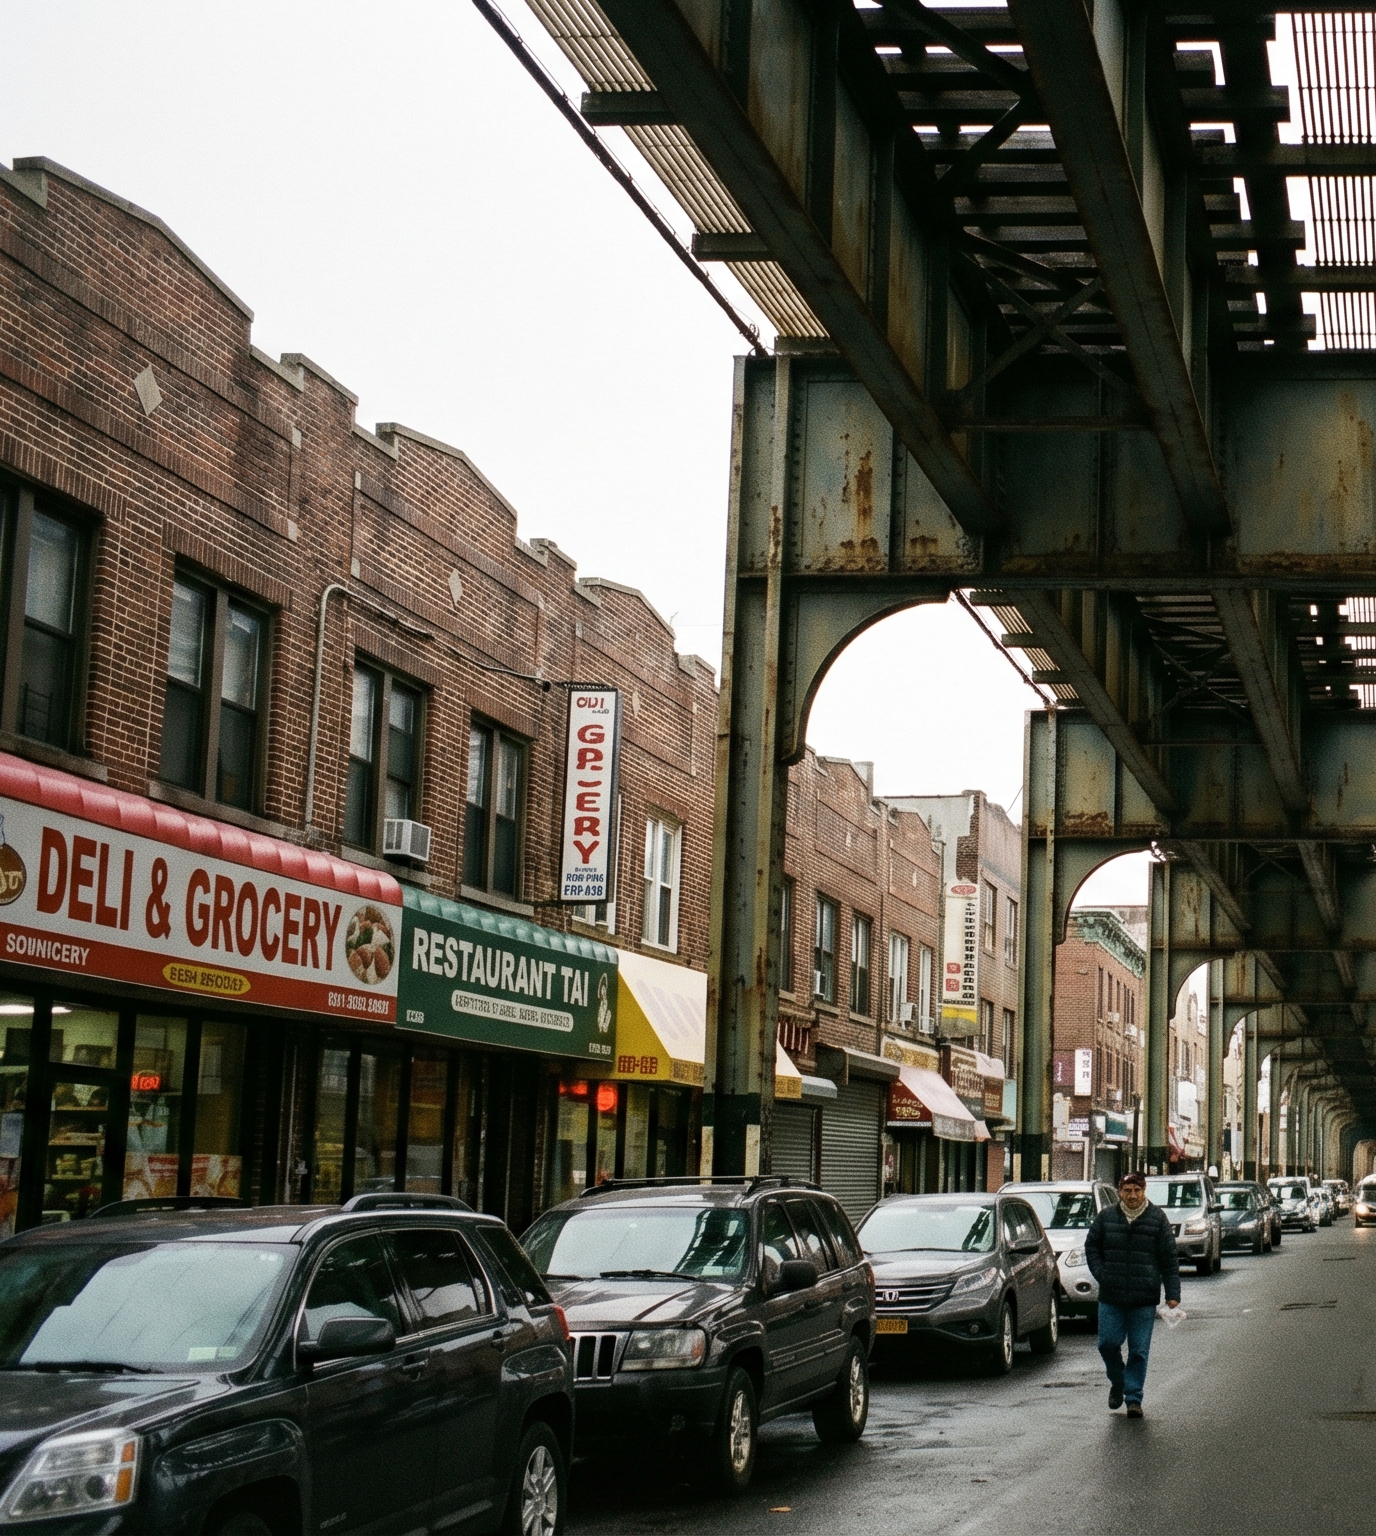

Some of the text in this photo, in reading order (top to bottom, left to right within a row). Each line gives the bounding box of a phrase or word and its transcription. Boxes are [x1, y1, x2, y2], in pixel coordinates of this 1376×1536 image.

[37, 826, 343, 971] DELI & GROCERY
[411, 927, 589, 1008] RESTAURANT TAI
